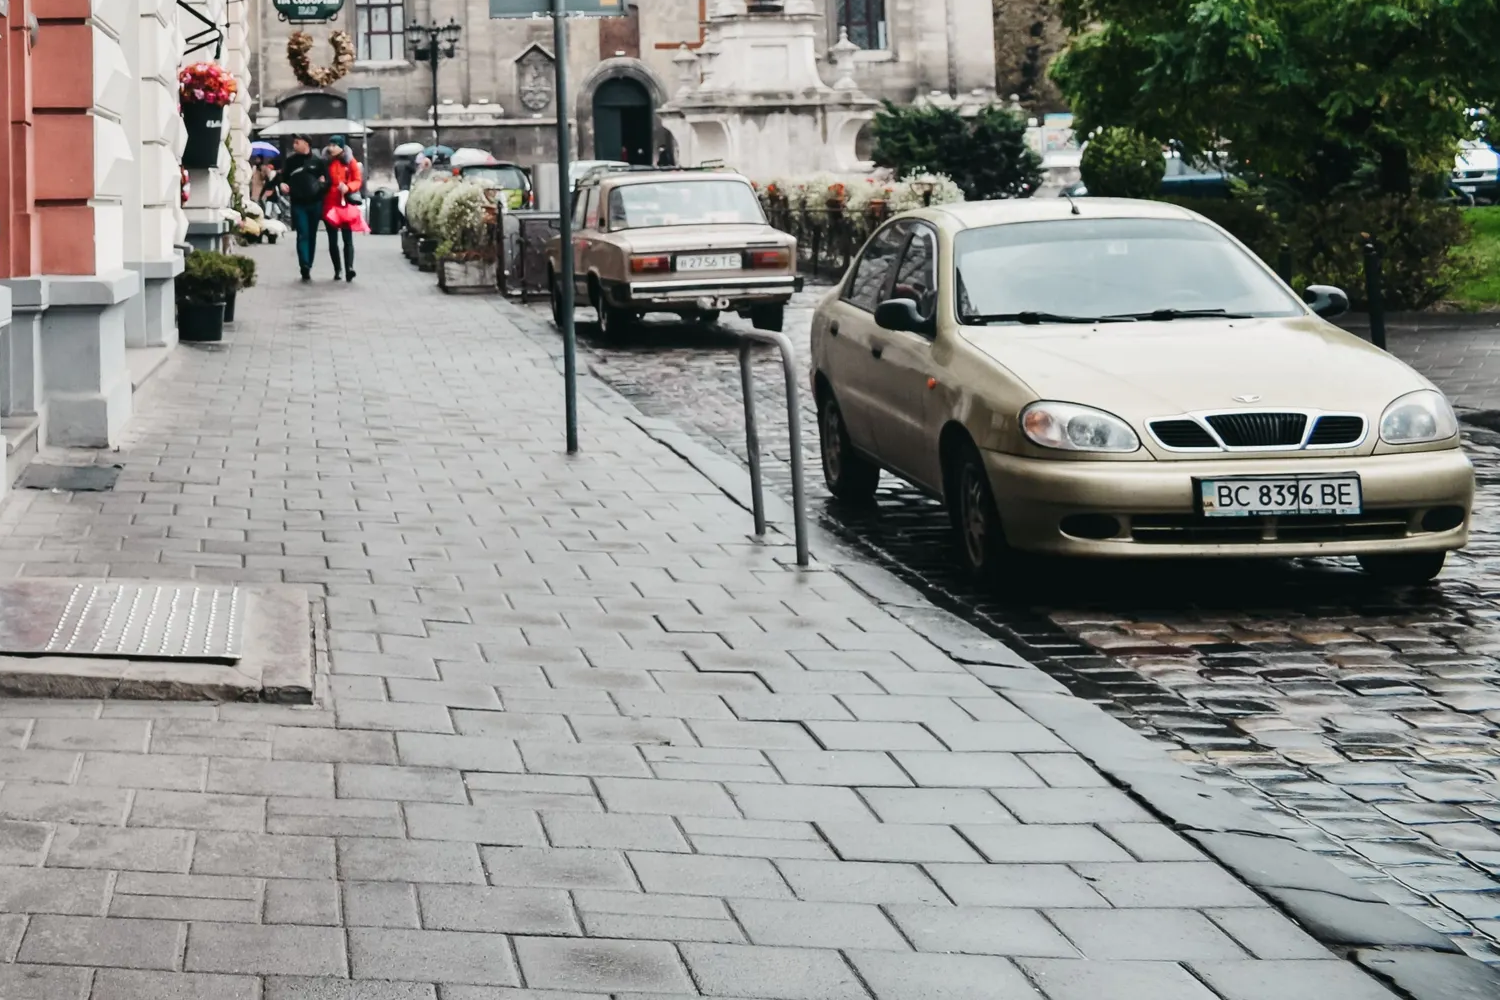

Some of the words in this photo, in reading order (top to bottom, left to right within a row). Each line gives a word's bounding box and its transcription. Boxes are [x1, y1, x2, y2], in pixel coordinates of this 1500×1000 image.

[1217, 485, 1250, 507] BC
[1258, 484, 1314, 507] 8396
[1320, 483, 1353, 505] BE
